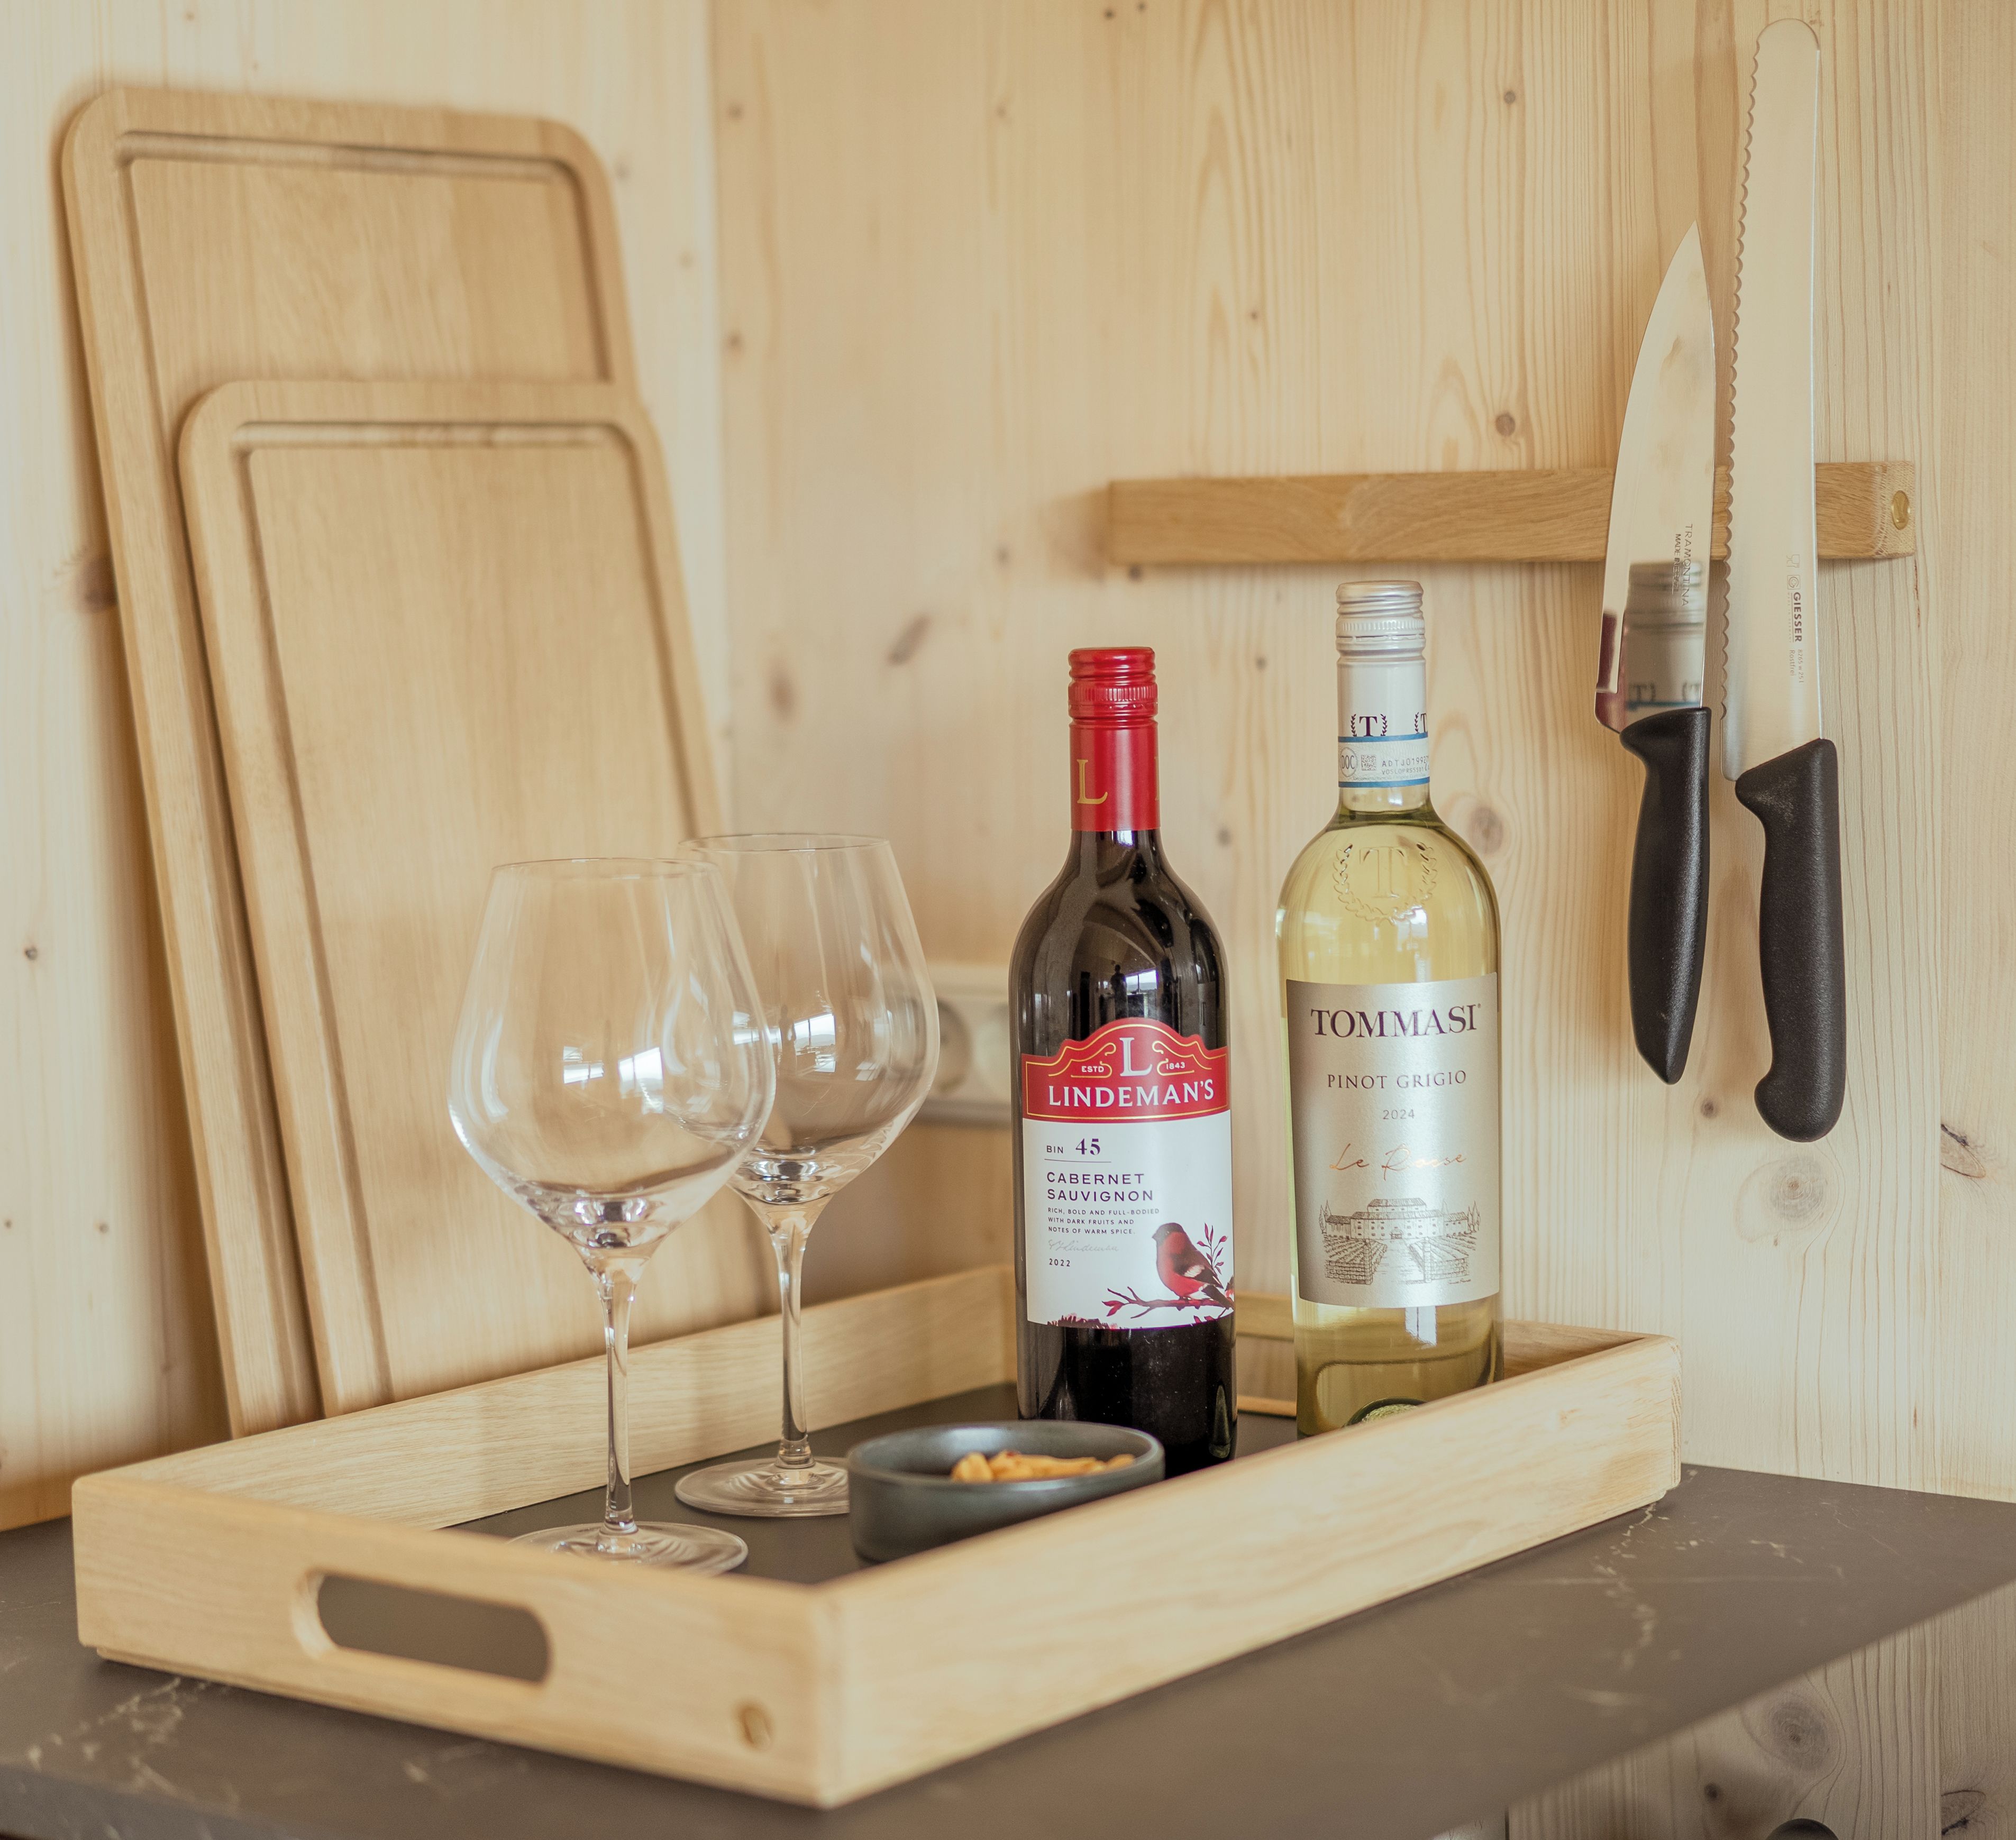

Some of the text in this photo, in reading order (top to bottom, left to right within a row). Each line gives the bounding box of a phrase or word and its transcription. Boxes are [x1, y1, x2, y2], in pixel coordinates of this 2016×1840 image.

[1682, 524, 1693, 607] TRAMONTINA
[1793, 592, 1802, 642] GIESSER
[1359, 716, 1378, 736] T
[1341, 755, 1355, 770] DOC
[1077, 759, 1108, 804] L
[1310, 1004, 1478, 1038] TOMMASI
[1119, 1037, 1153, 1077] L
[1165, 1061, 1185, 1070] 1843
[1327, 1070, 1467, 1090] PINOT GRIGIO
[1048, 1078, 1214, 1107] LINDEMAN'S
[1382, 1109, 1416, 1120] 2024
[1046, 1138, 1101, 1156] BIN 45
[1329, 1143, 1370, 1170] Le
[1046, 1171, 1145, 1185] CABERNET
[1047, 1188, 1154, 1202] SAUVIGNON
[1048, 1258, 1071, 1267] 2022
